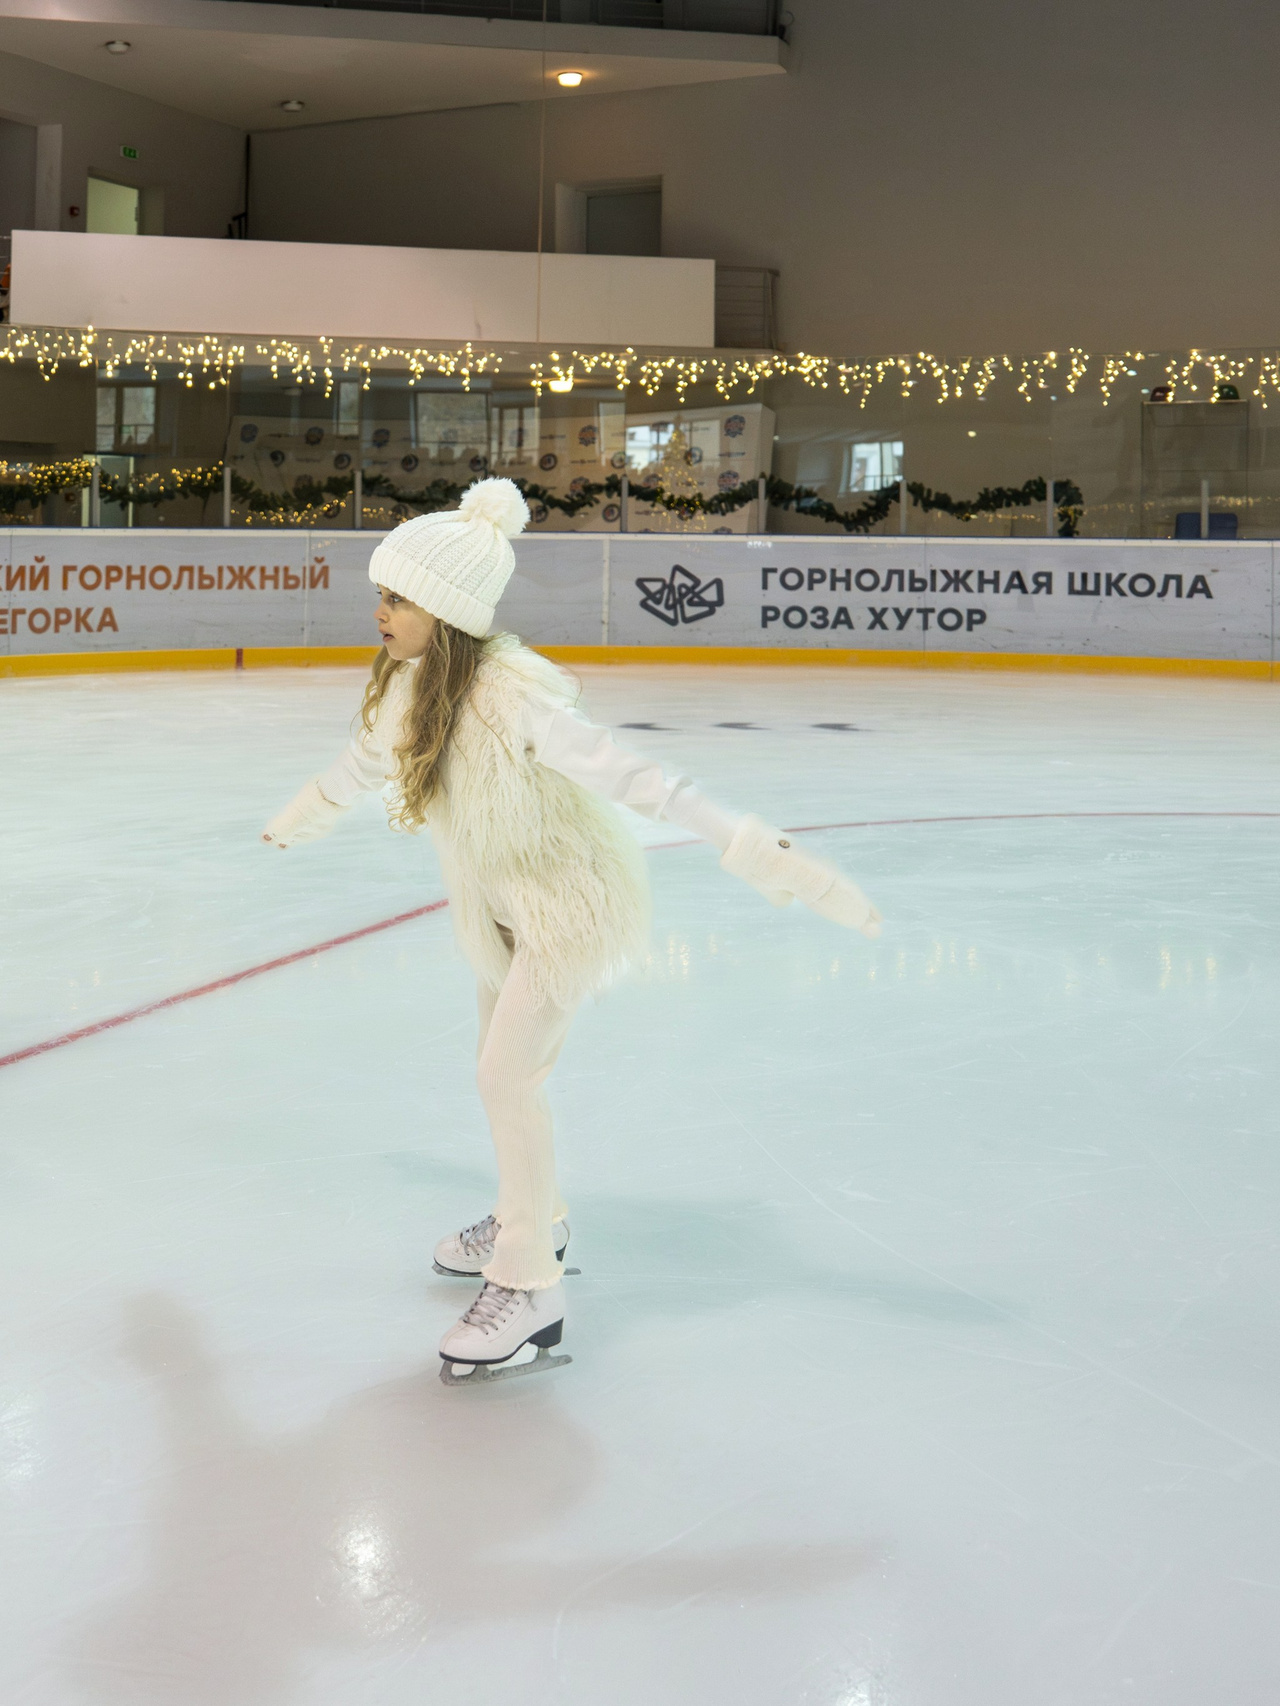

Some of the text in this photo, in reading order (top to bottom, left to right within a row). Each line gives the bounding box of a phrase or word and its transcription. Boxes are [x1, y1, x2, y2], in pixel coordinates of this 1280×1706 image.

[62, 556, 330, 591] ГОРНОЛЫЖНЫЙ
[761, 567, 1214, 600] ГОРНОЛЫЖНАЯ ШКОЛА
[760, 605, 988, 633] РОЗА ХУТОР
